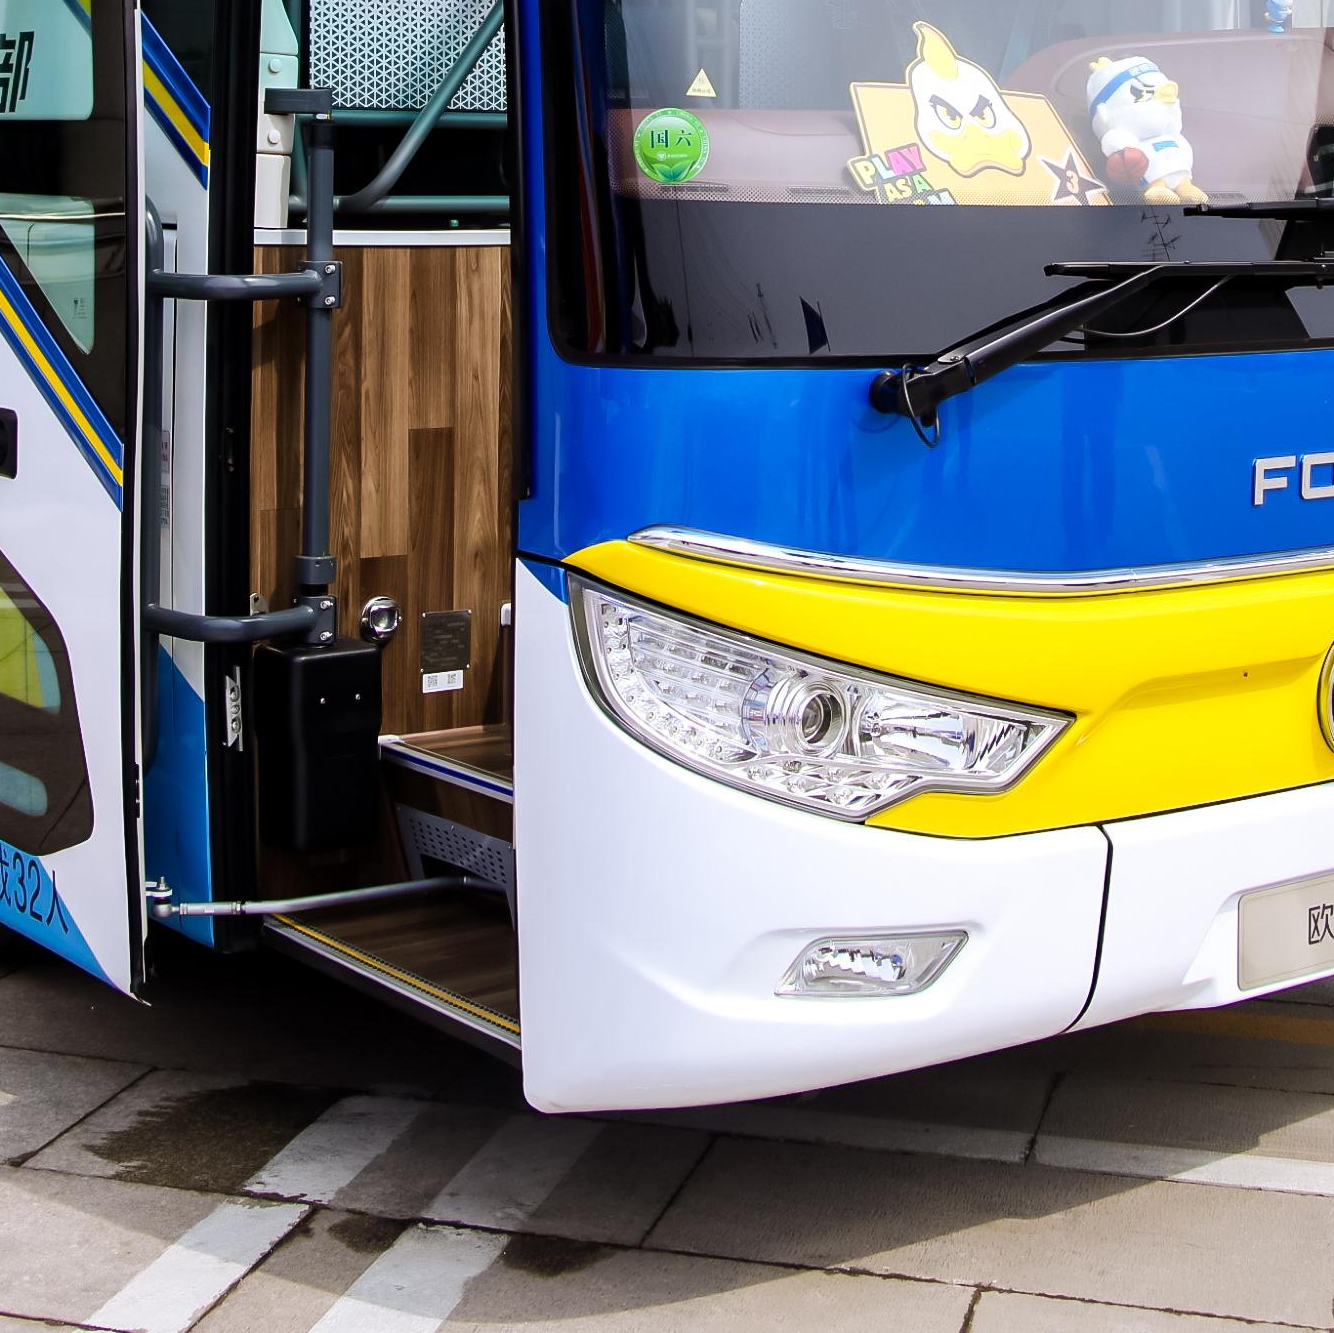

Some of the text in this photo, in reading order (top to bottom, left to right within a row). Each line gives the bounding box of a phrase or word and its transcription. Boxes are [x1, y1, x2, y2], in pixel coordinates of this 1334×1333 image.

[650, 129, 692, 149] 国六
[854, 145, 924, 185] PLAY
[884, 178, 913, 203] AS
[911, 173, 933, 194] A
